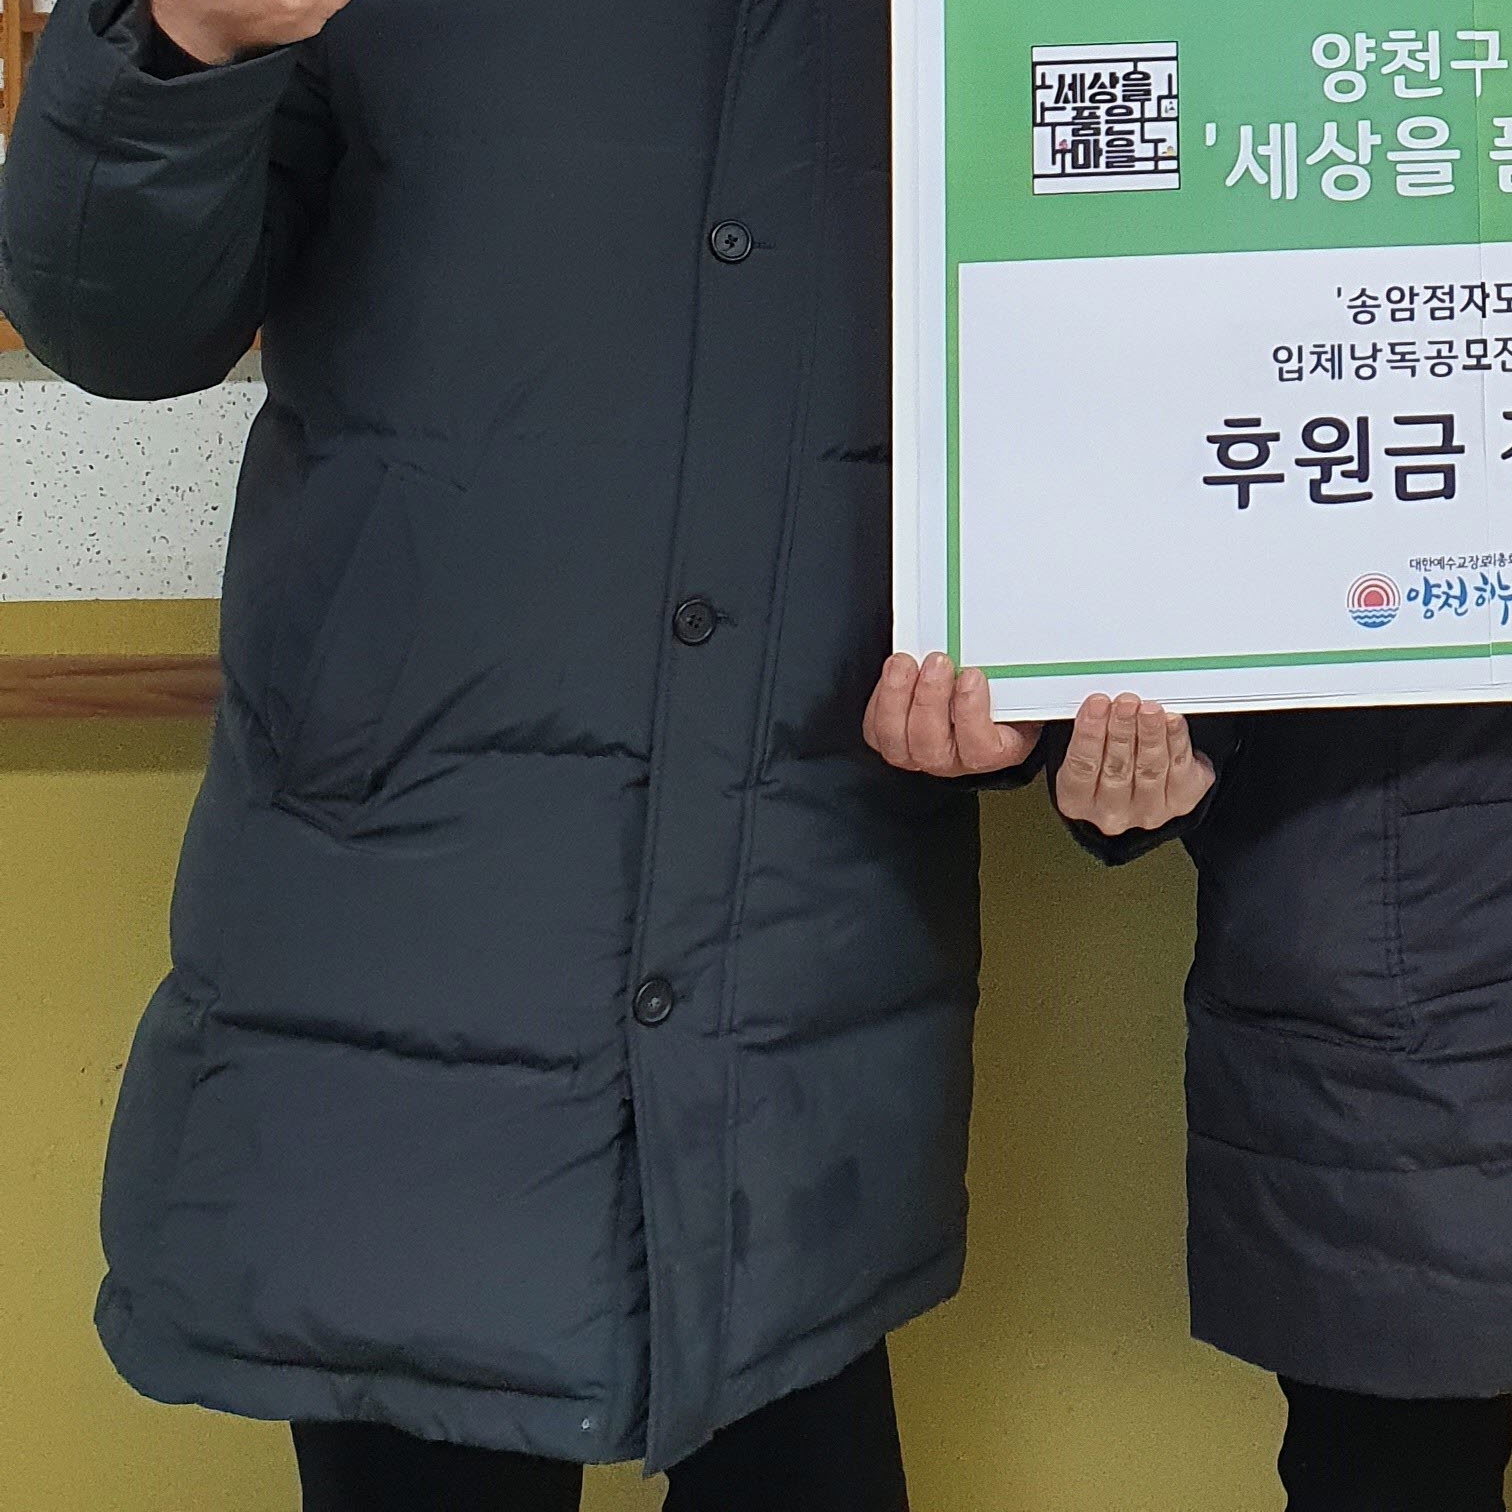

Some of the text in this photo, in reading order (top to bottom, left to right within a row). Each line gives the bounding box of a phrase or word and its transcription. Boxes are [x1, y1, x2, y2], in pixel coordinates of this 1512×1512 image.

[1053, 70, 1153, 105] 세상을
[1071, 104, 1136, 138] 품은
[1070, 137, 1136, 170] 마을
[1204, 114, 1462, 201] '세상을
[1202, 413, 1467, 510] 후원금
